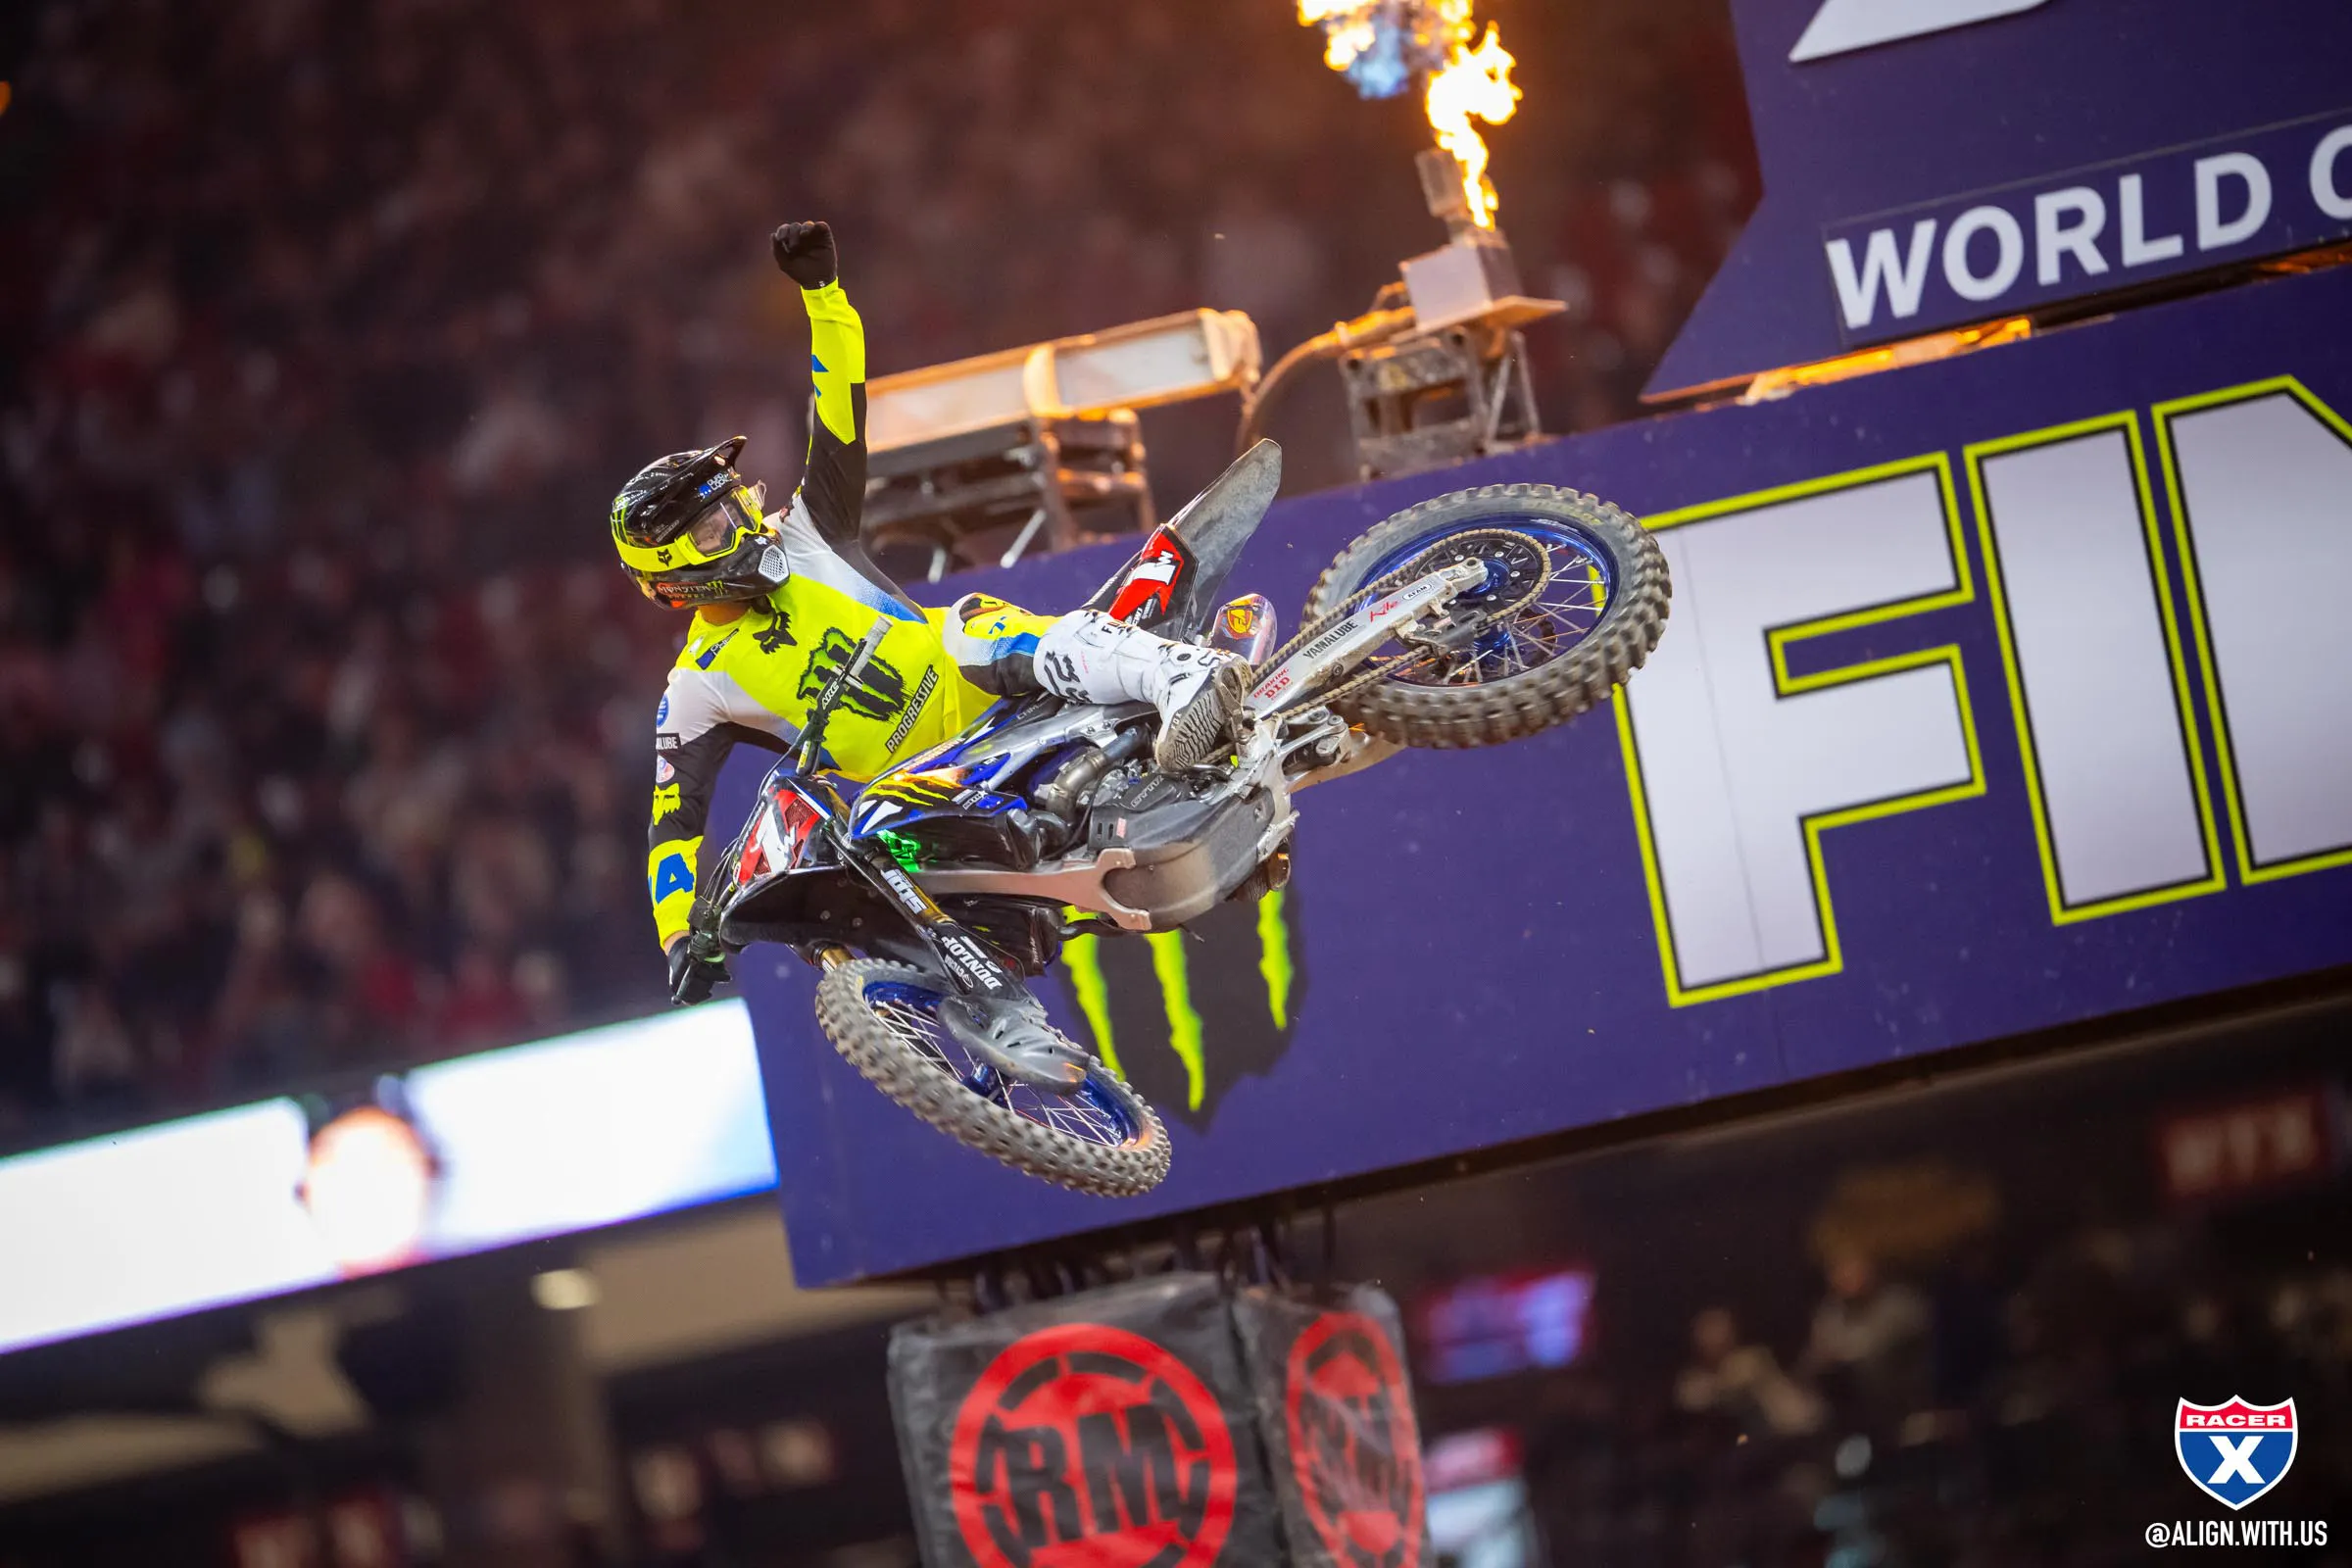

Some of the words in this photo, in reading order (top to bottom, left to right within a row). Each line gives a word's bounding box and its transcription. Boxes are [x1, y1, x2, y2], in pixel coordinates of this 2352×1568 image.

[1826, 152, 2272, 328] WORLD
[1302, 618, 1359, 660] YAMALUBE
[886, 667, 939, 754] PROGRESSIVE
[941, 936, 1004, 991] DUNLOP
